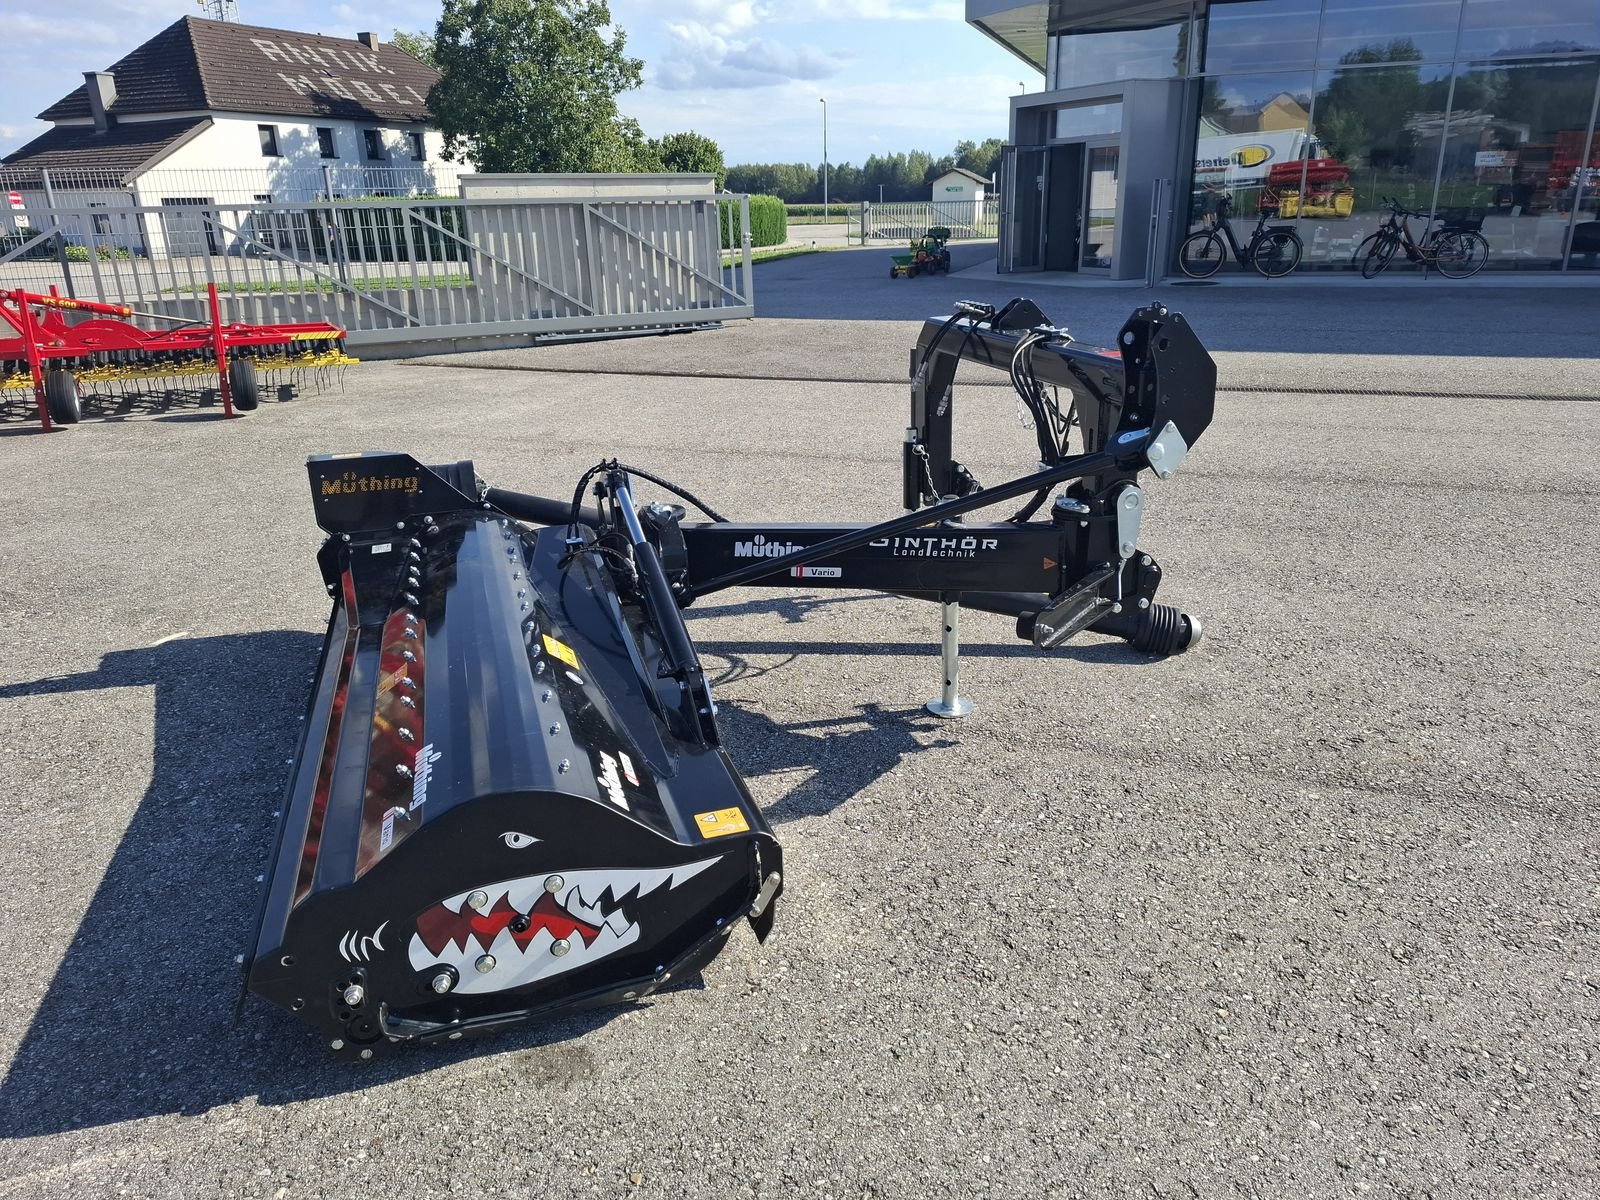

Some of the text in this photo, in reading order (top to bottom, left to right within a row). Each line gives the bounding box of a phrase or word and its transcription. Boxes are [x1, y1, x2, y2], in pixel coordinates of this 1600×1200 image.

[250, 38, 395, 75] ANTIK
[42, 297, 56, 307] VS
[58, 300, 77, 309] 600
[321, 471, 418, 495] Müthing
[811, 568, 835, 576] Vario
[409, 743, 442, 811] Müthing
